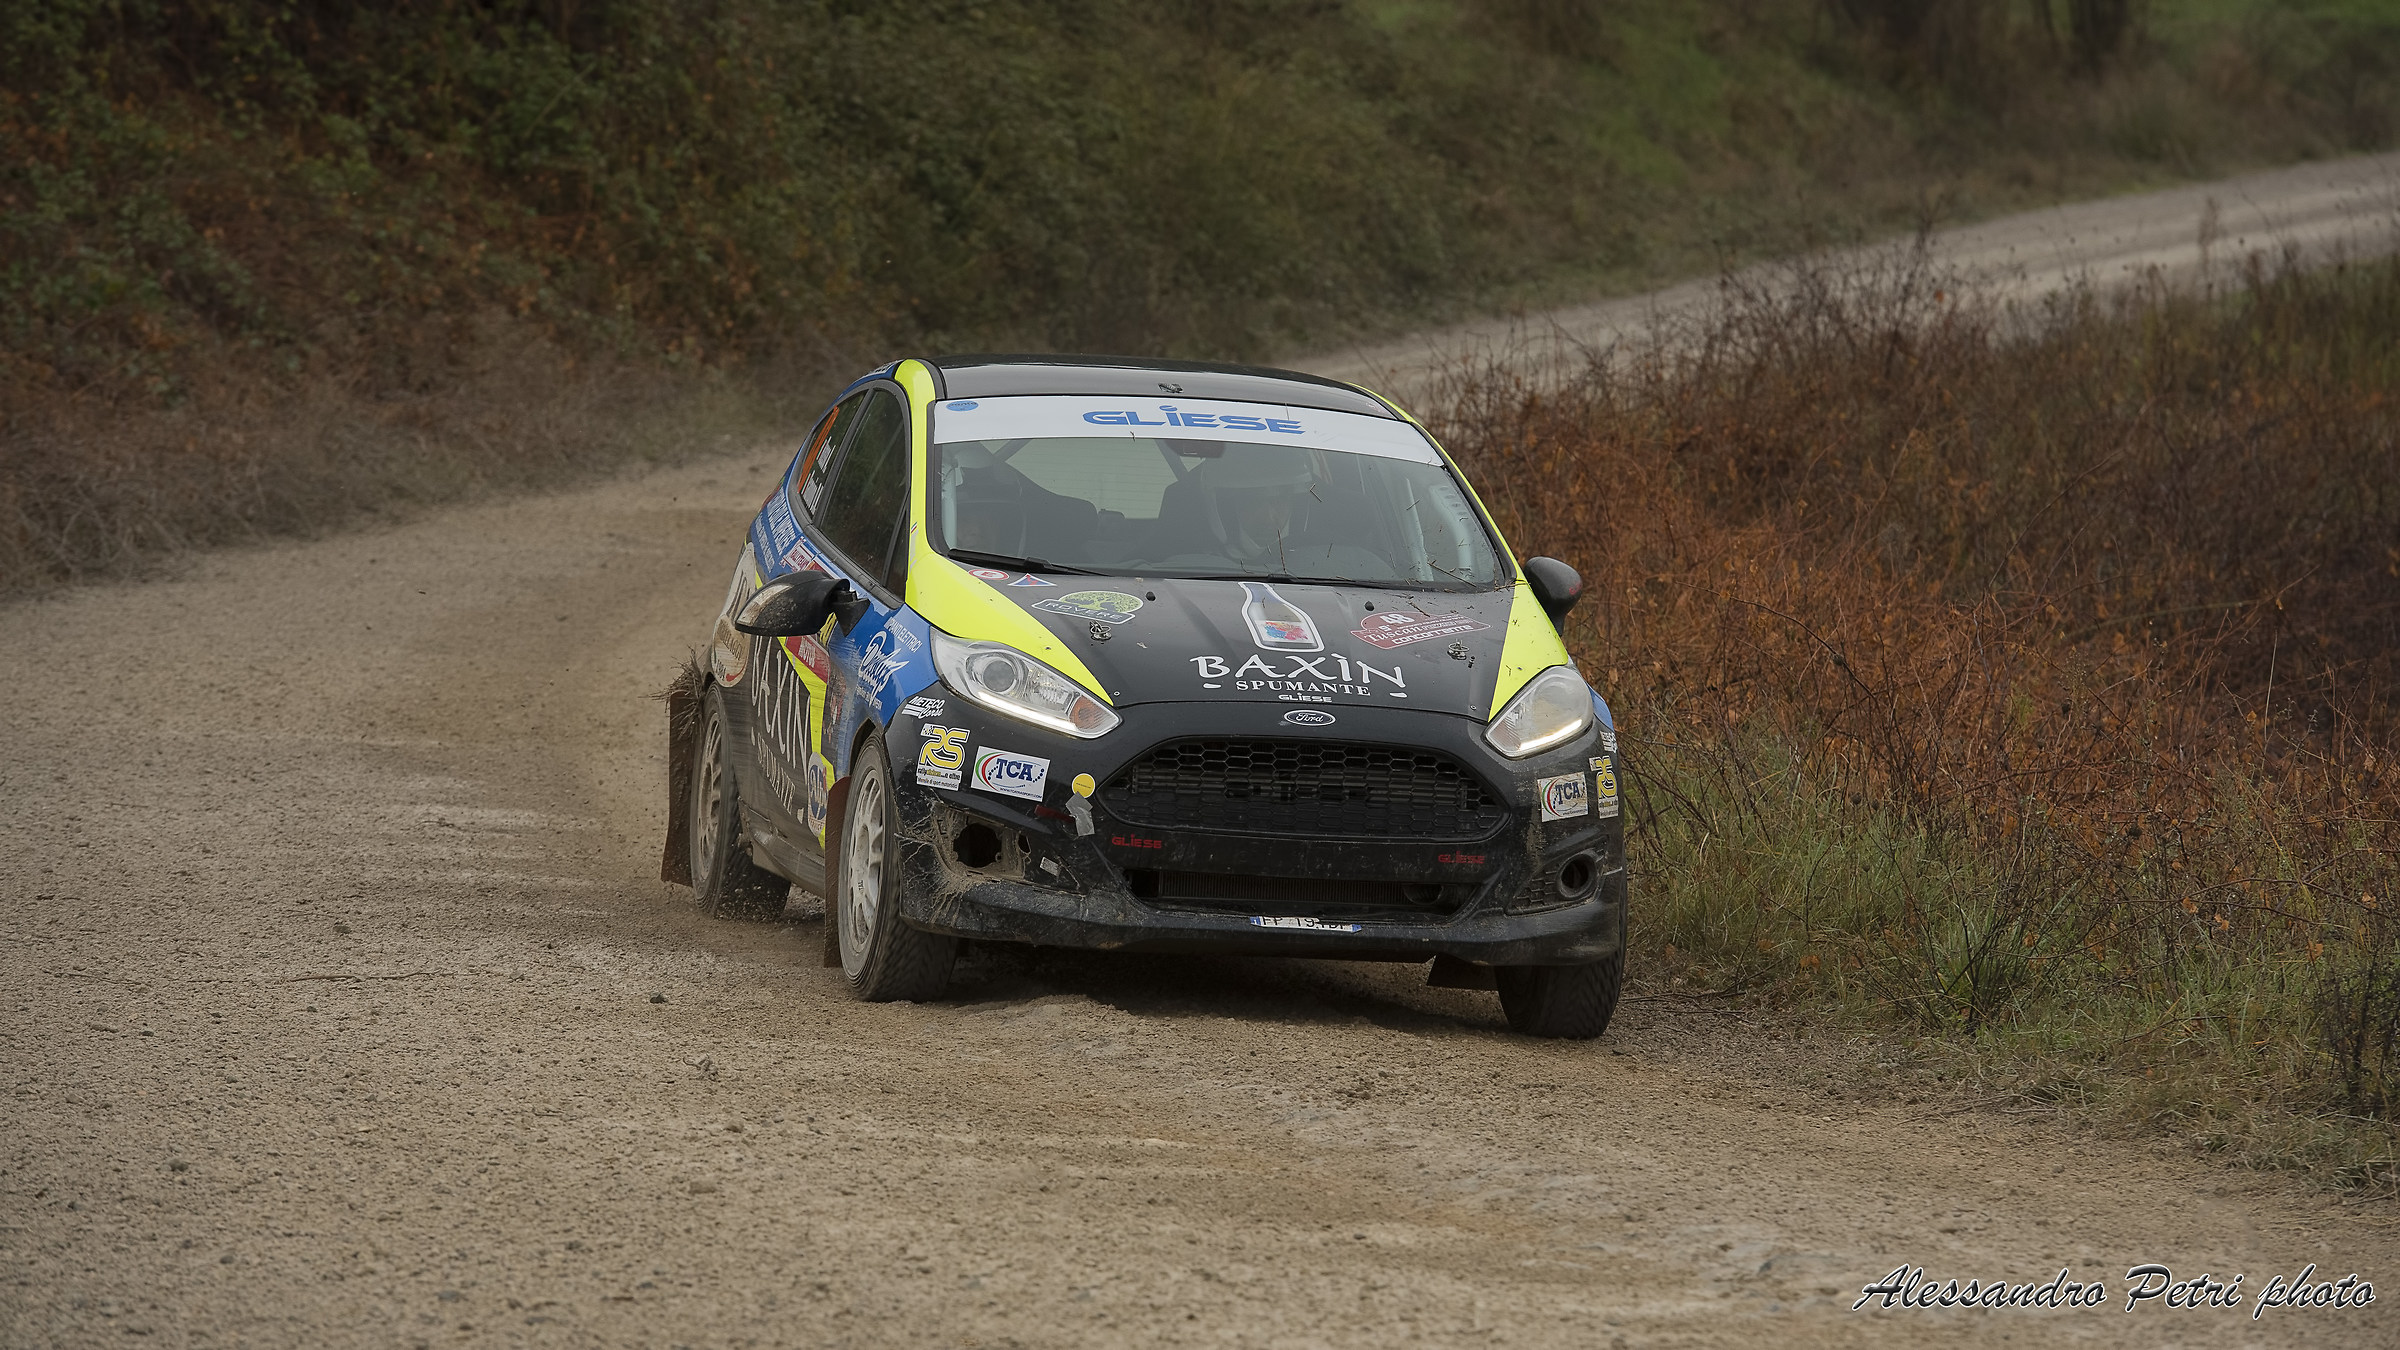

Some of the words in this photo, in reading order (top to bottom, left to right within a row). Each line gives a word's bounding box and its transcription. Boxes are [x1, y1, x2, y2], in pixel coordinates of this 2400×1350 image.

[1045, 602, 1123, 620] ROVERE
[1381, 613, 1416, 625] 48
[1365, 625, 1425, 642] Tuscan
[1236, 680, 1371, 697] SPUMANTE
[909, 695, 946, 708] METECO
[1295, 712, 1325, 723] Ford
[996, 758, 1033, 782] TCA
[1555, 781, 1580, 805] TCA
